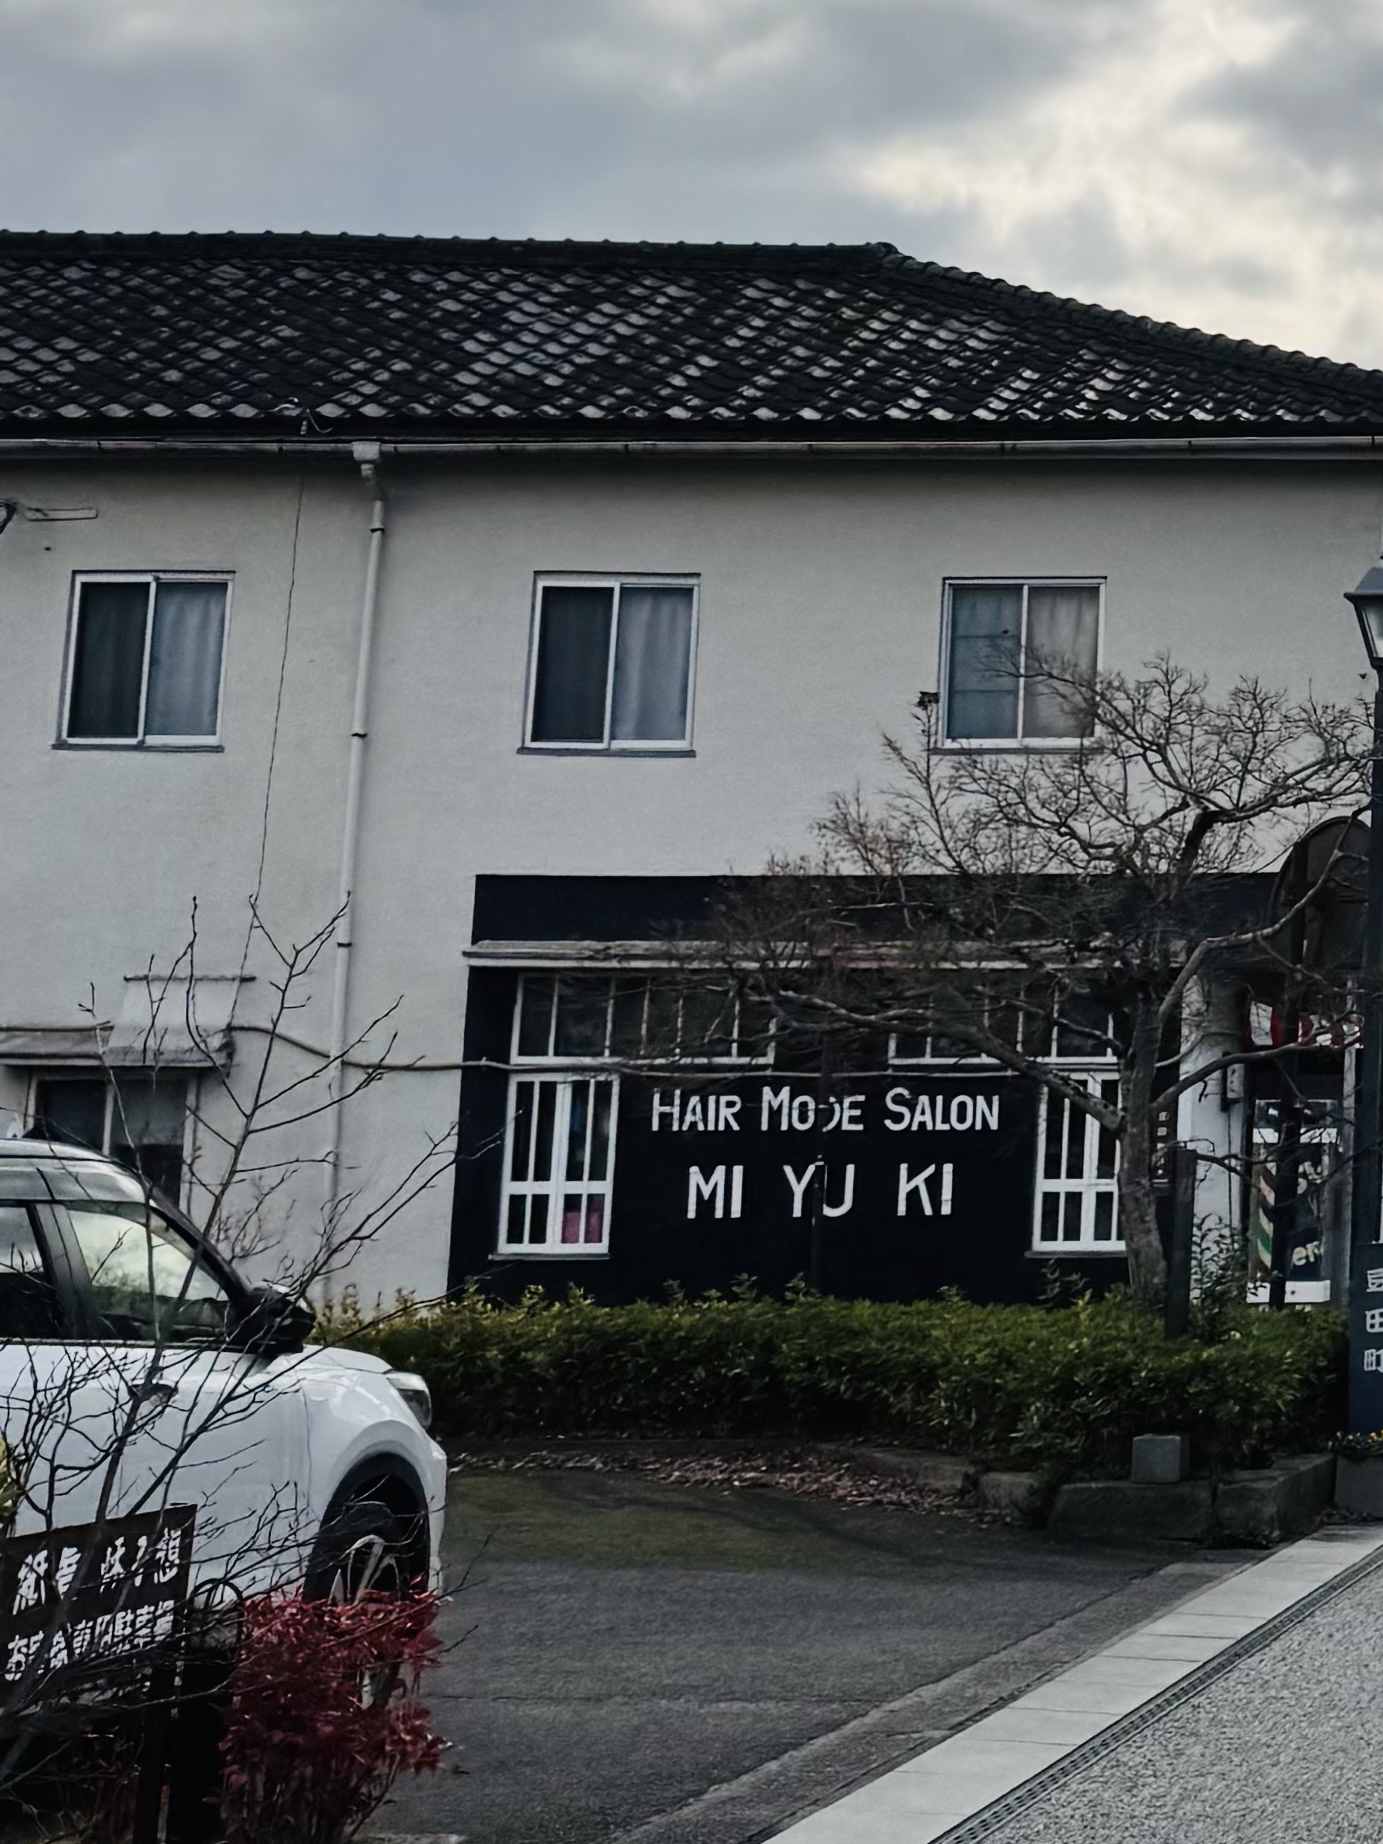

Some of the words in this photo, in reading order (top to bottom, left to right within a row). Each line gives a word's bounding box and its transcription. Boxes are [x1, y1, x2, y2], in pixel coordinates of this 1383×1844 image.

[651, 1088, 742, 1132] HAIR
[761, 1086, 865, 1133] MODE
[883, 1086, 1000, 1132] SALON
[687, 1164, 744, 1219] MI
[897, 1162, 954, 1217] KI
